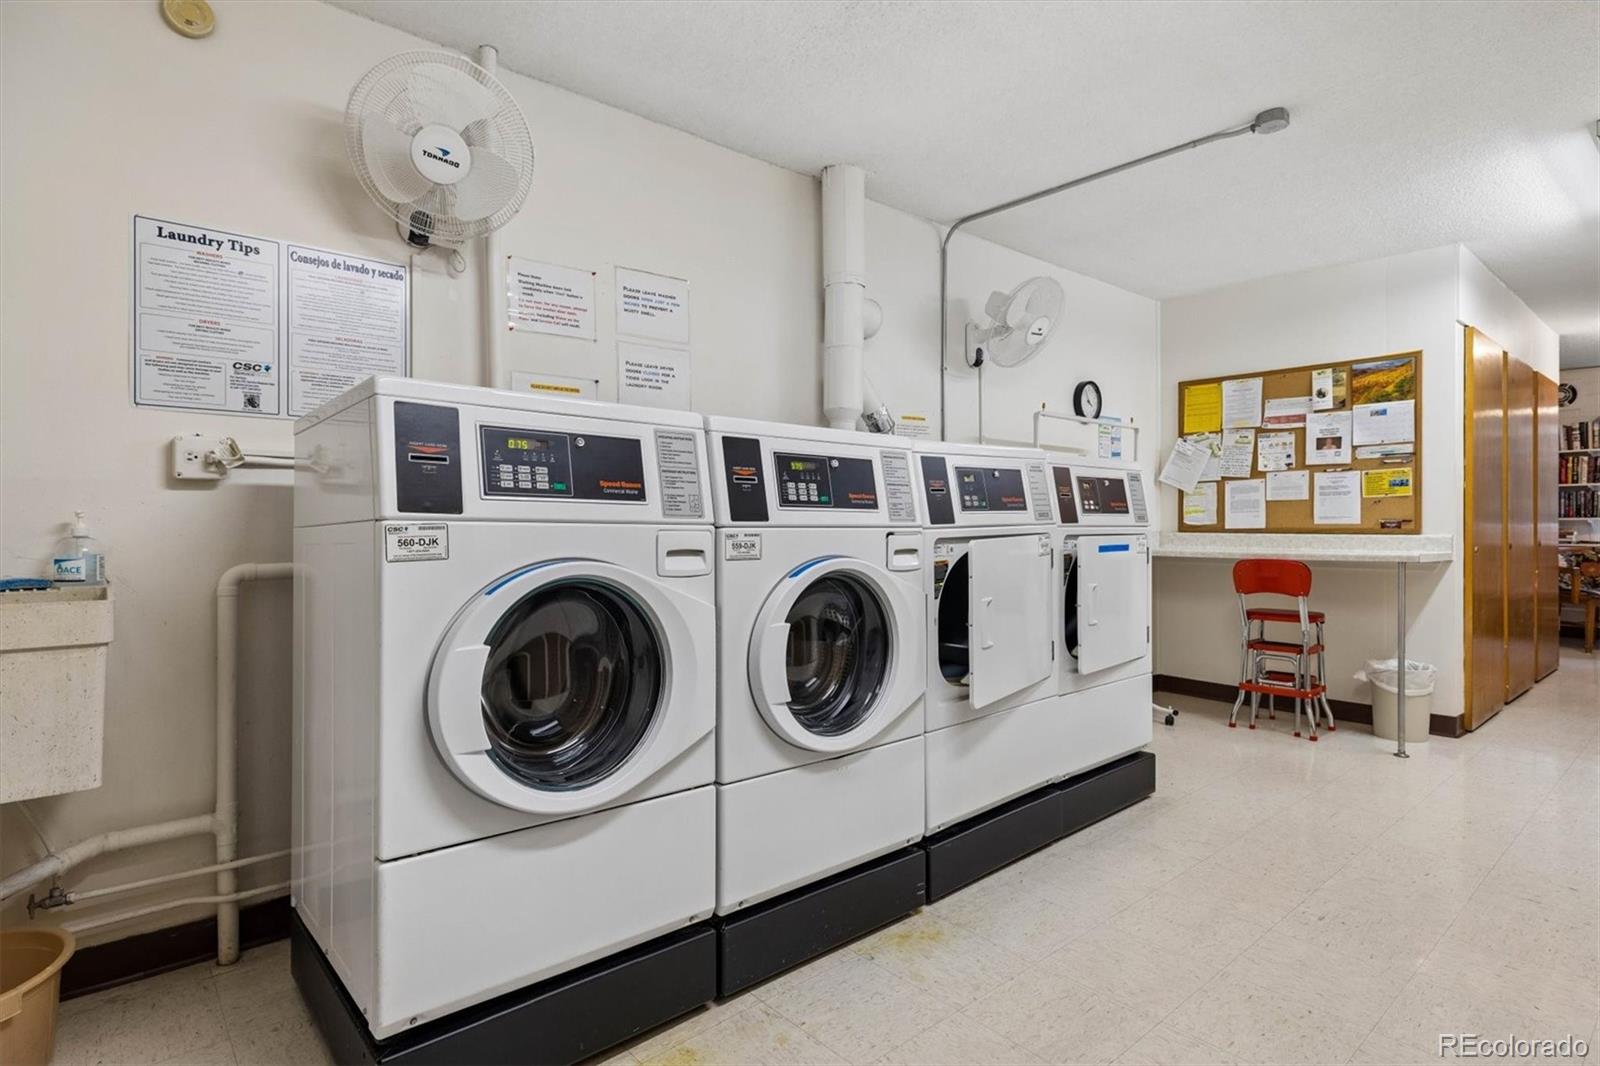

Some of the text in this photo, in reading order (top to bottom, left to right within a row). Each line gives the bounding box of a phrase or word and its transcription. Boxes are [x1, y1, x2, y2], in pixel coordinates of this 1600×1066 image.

[422, 149, 460, 169] TORNADO
[157, 226, 260, 256] Laundry Tips
[290, 251, 404, 281] Consejos de lavado y secado
[233, 362, 262, 372] CSC
[397, 537, 439, 547] 560-DJK
